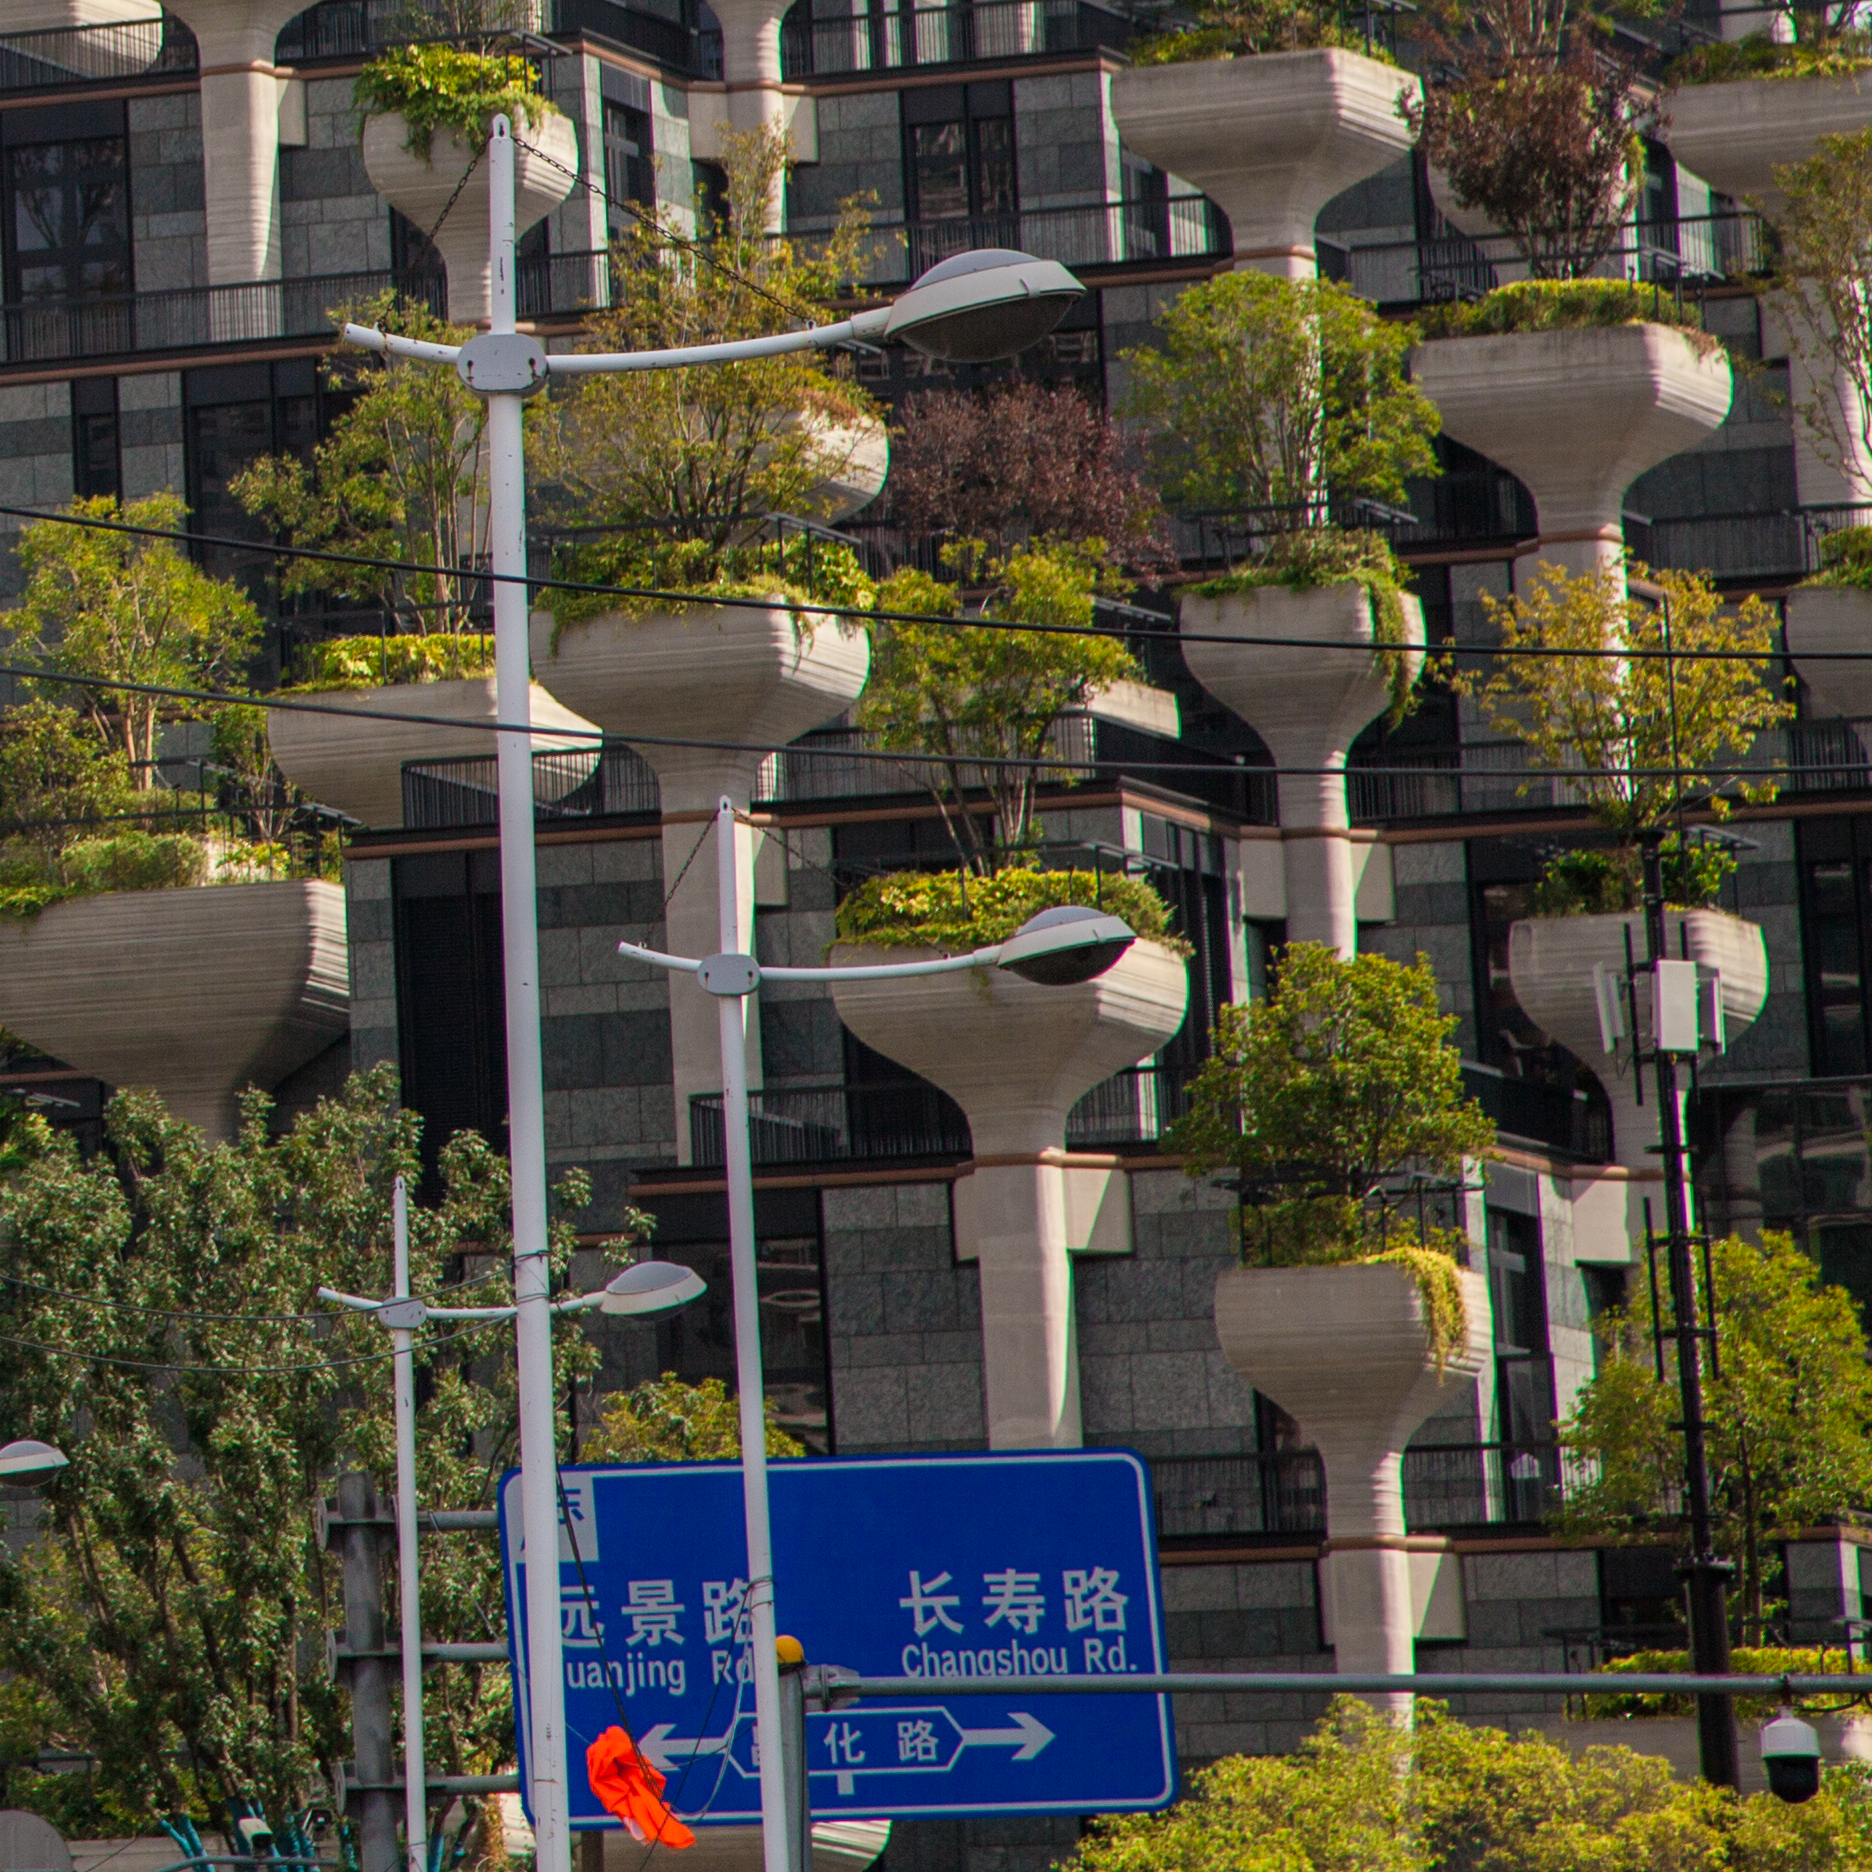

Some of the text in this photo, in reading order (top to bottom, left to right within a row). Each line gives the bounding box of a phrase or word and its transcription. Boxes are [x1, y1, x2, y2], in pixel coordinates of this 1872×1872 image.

[899, 1566, 1129, 1637] 长寿路
[566, 1651, 687, 1695] uanjing
[902, 1635, 1138, 1678] Changshou Rd.
[751, 1719, 939, 1766] 化路
